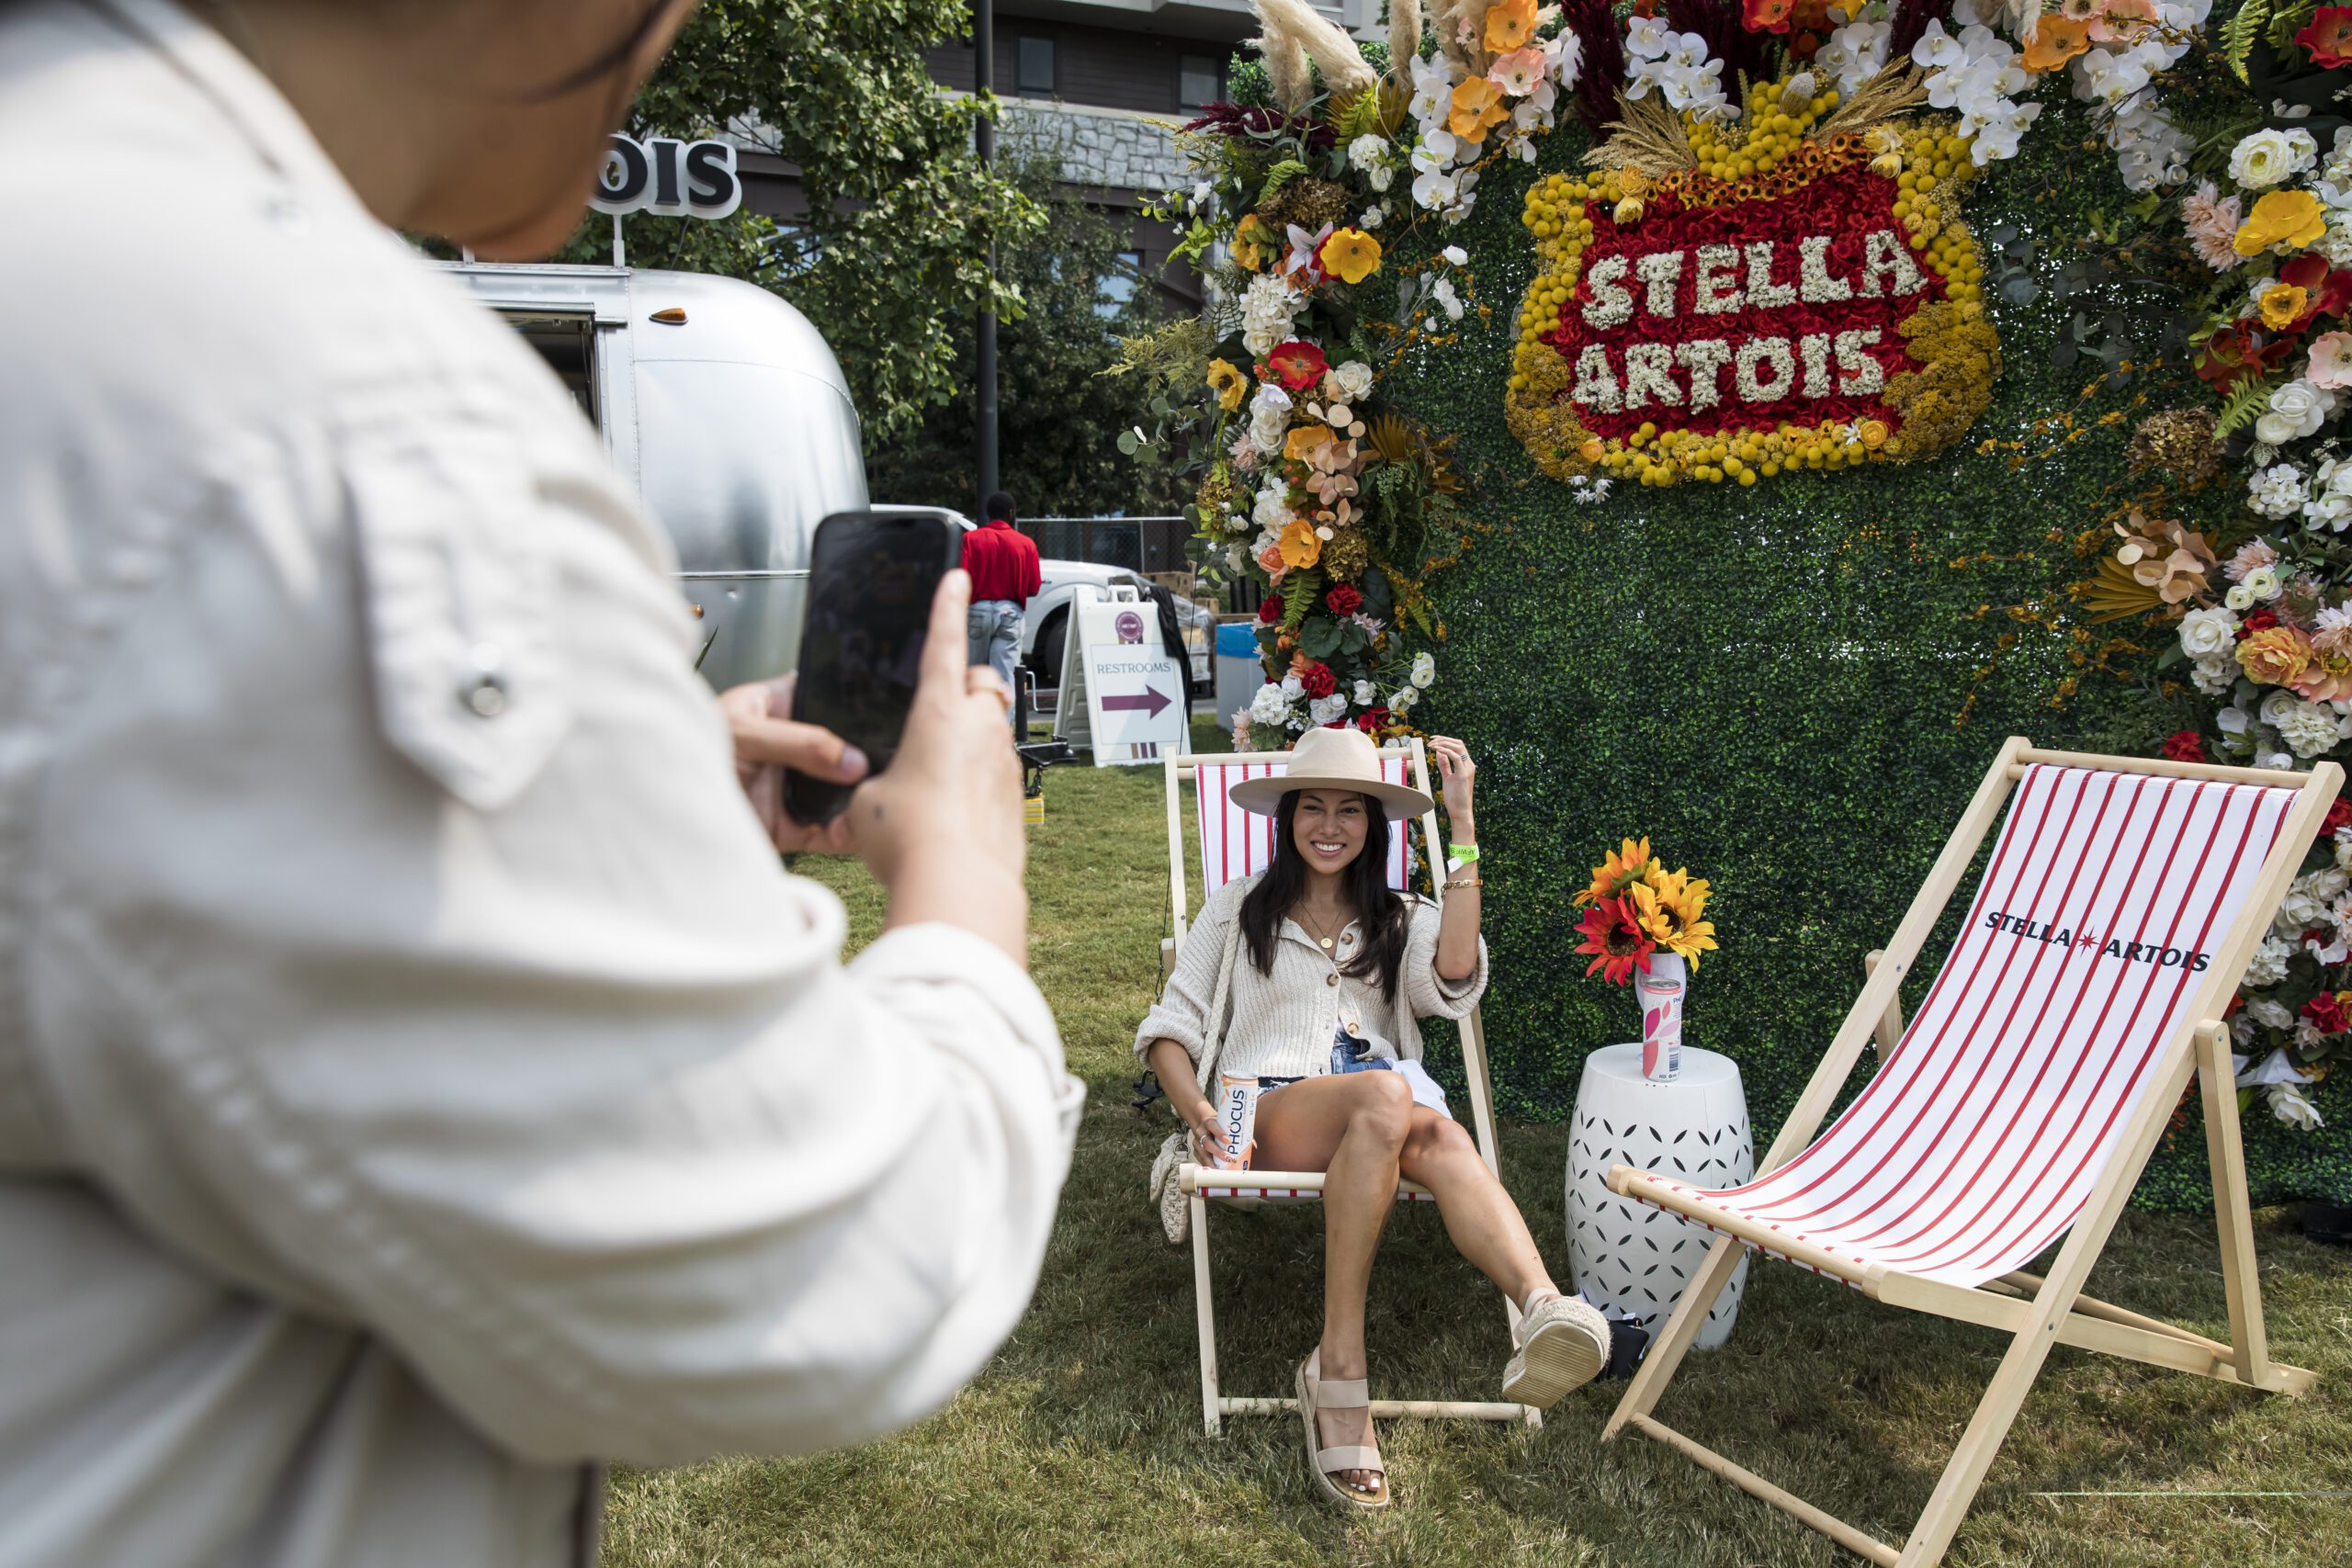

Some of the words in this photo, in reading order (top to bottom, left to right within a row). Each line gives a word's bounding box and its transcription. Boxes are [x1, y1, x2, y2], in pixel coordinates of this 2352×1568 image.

[595, 139, 734, 207] OIS
[1581, 230, 1928, 331] STELLA
[1571, 324, 1884, 416] ARTOIS
[1097, 662, 1170, 674] RESTROOMS
[1984, 911, 2071, 947] STELLA
[2101, 939, 2211, 972] ARTOIS
[1227, 1089, 1245, 1156] PHOCUS
